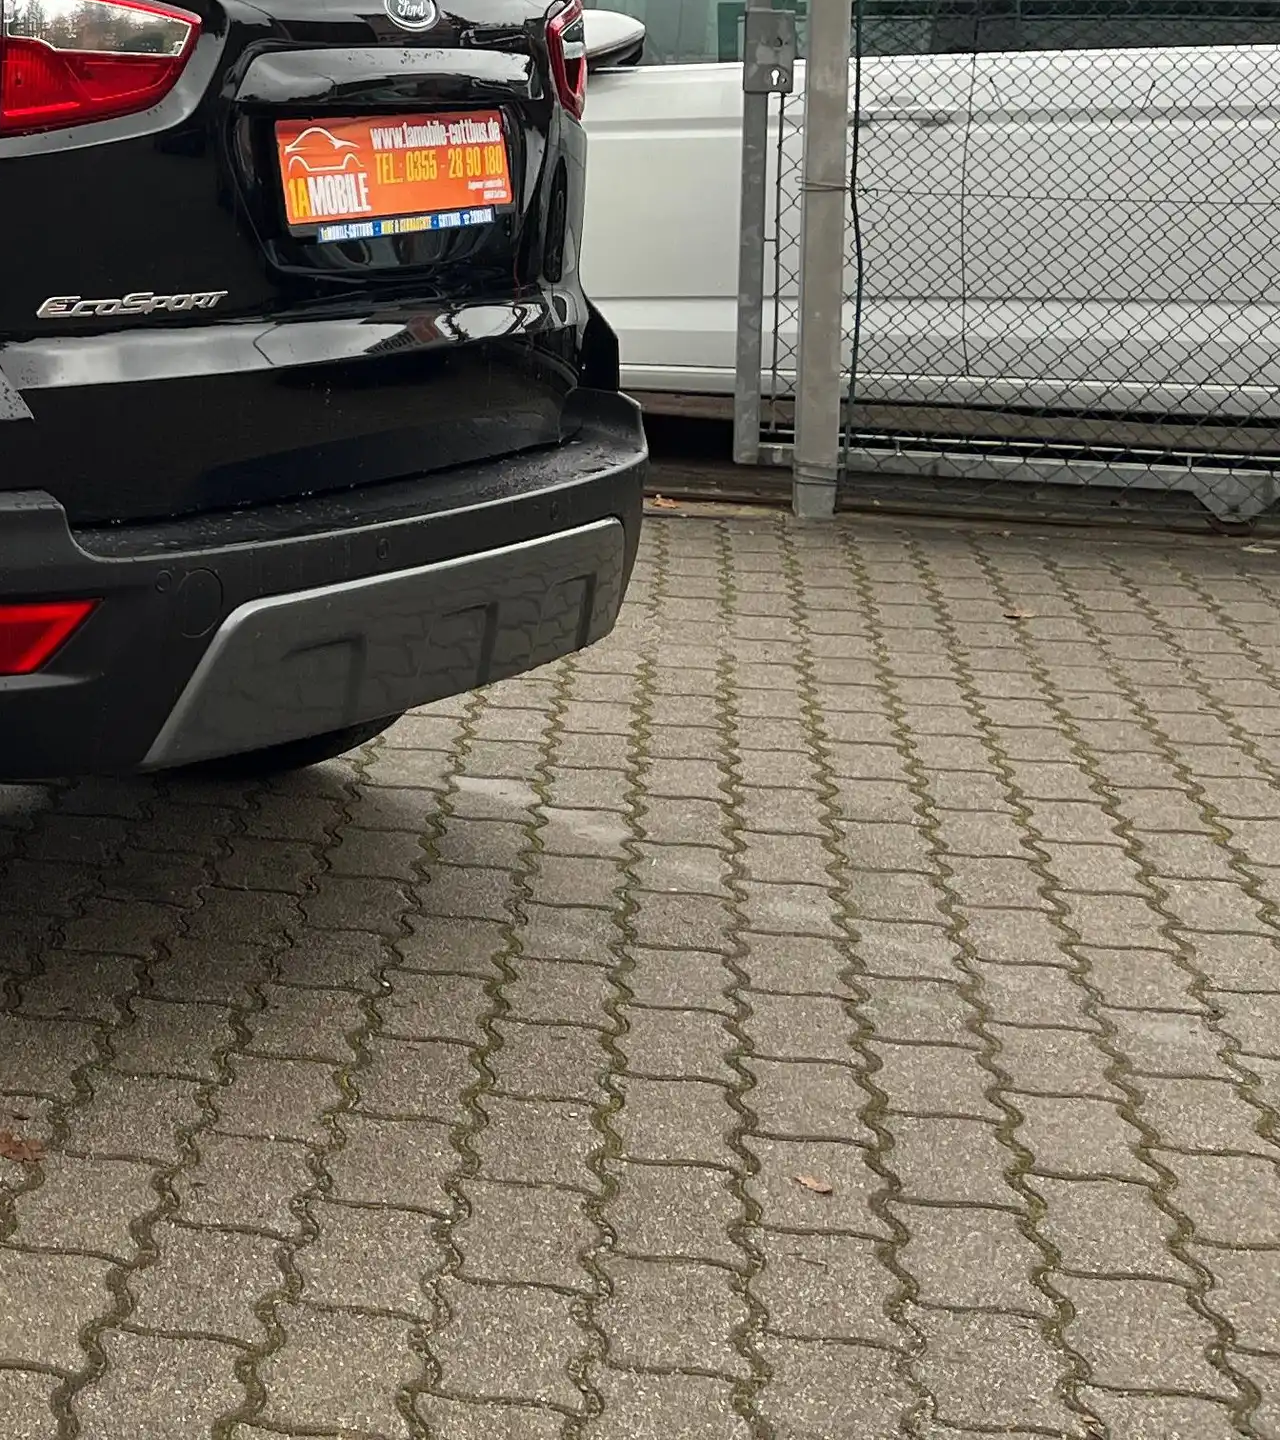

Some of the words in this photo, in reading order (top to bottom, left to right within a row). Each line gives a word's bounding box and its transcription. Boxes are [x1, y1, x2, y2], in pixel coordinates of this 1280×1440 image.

[369, 117, 502, 150] www.1amobile-cottbus.de
[375, 152, 403, 185] TEL.:
[405, 149, 437, 182] 0355
[447, 146, 463, 179] 28
[465, 146, 481, 177] 90
[484, 144, 503, 175] 180
[288, 172, 371, 219] 1AMOBILE
